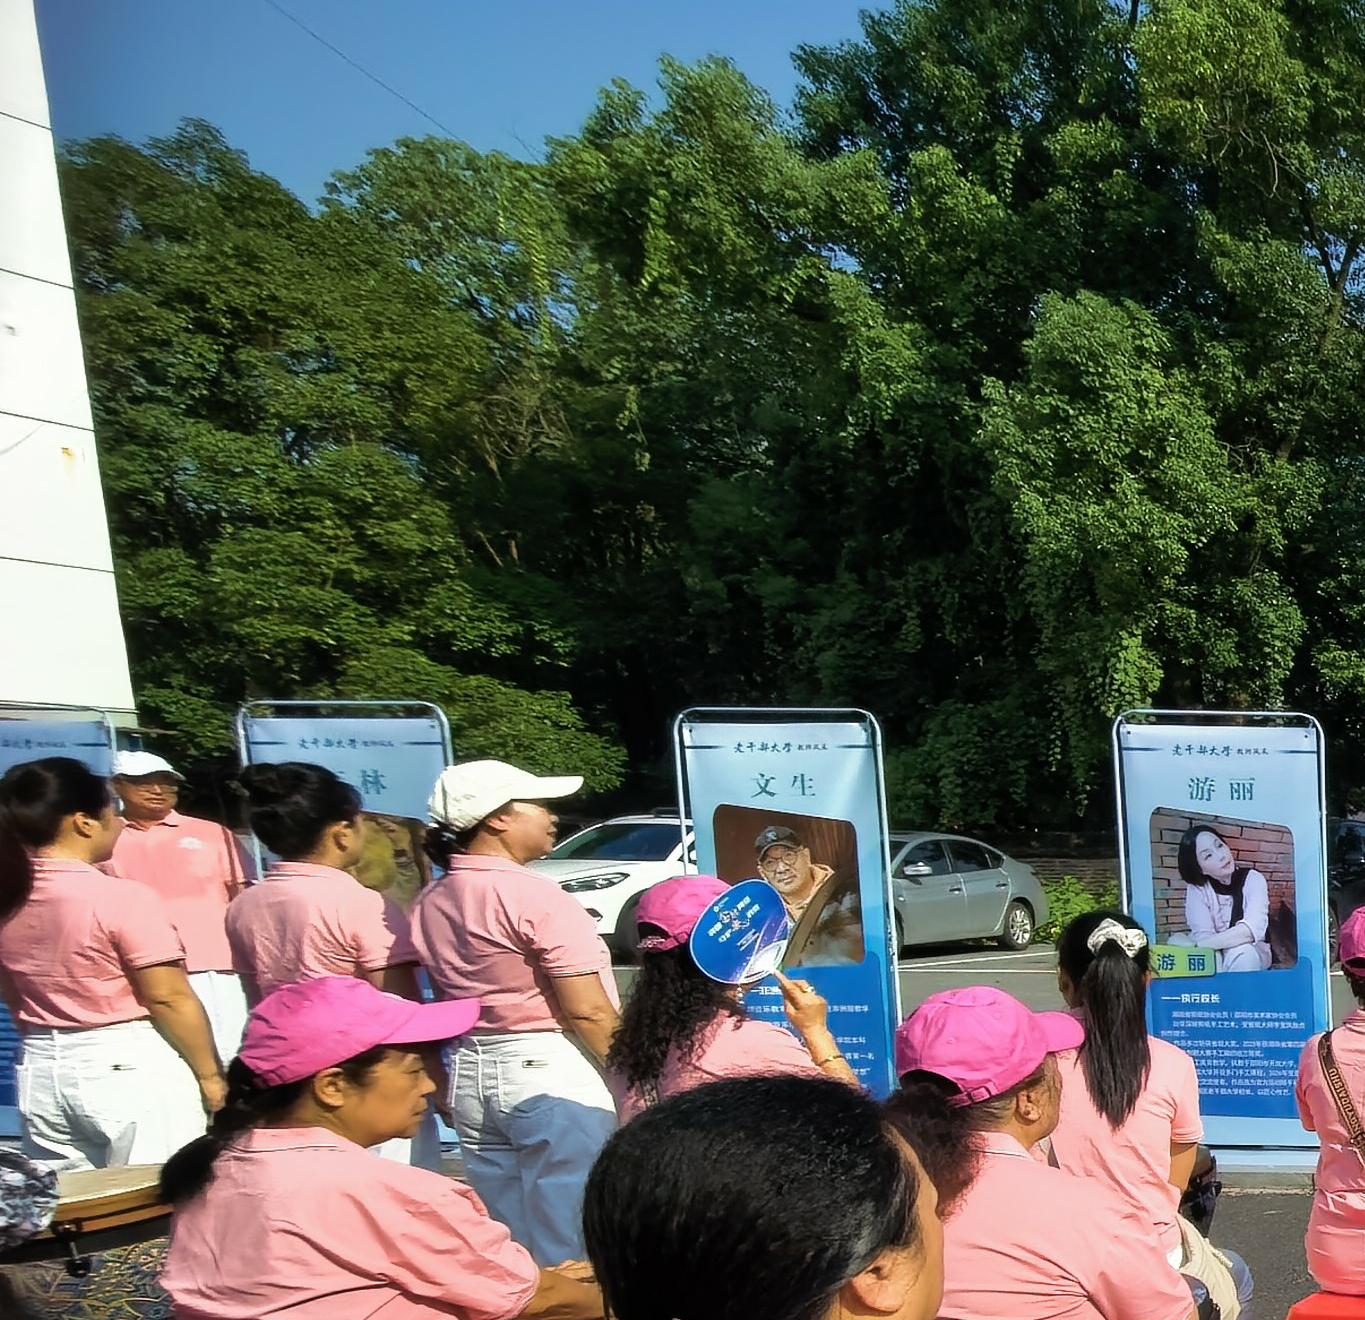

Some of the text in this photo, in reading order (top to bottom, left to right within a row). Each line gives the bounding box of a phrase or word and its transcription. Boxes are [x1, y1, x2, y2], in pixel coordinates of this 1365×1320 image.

[751, 772, 816, 798] 文生
[1188, 777, 1255, 801] 游丽
[1157, 953, 1206, 971] 游丽
